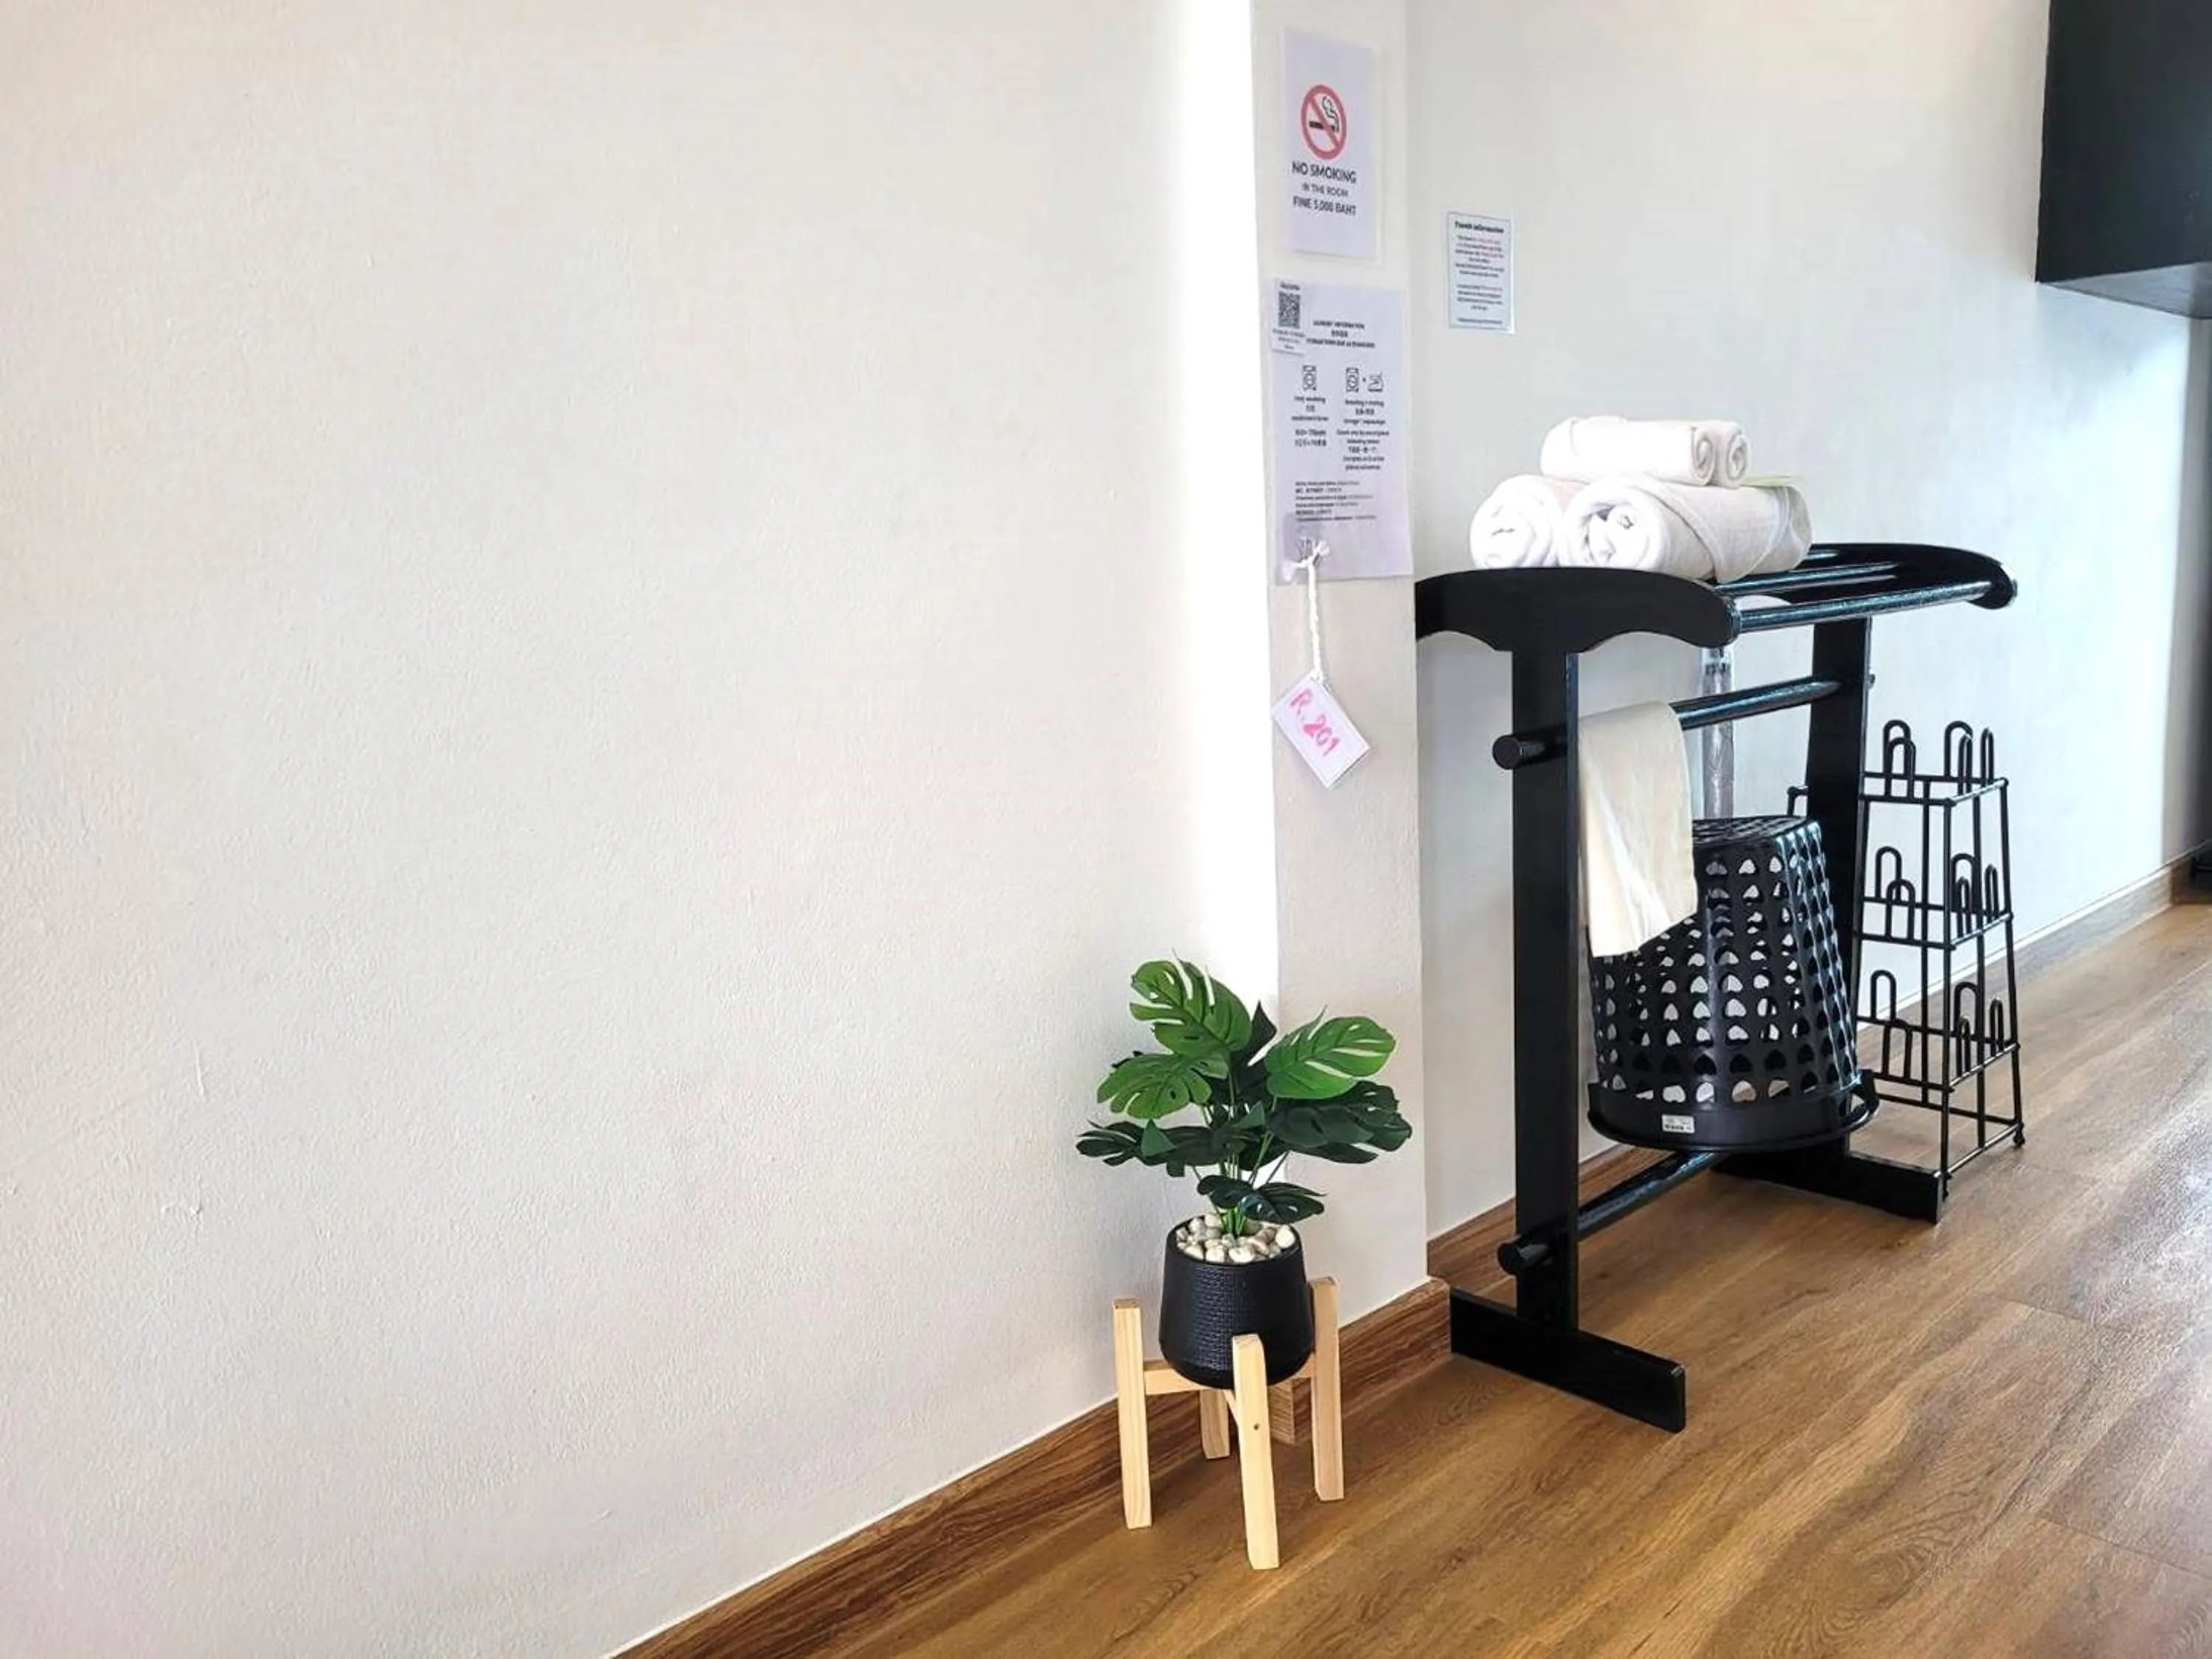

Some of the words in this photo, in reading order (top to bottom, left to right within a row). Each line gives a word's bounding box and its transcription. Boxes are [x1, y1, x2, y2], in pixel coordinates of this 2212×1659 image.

[1292, 160, 1308, 175] NO
[1310, 164, 1356, 184] SMOKING
[1327, 187, 1349, 197] ROOM
[1293, 195, 1311, 209] FINE
[1335, 203, 1356, 216] BAHT
[1303, 713, 1340, 756] 201
